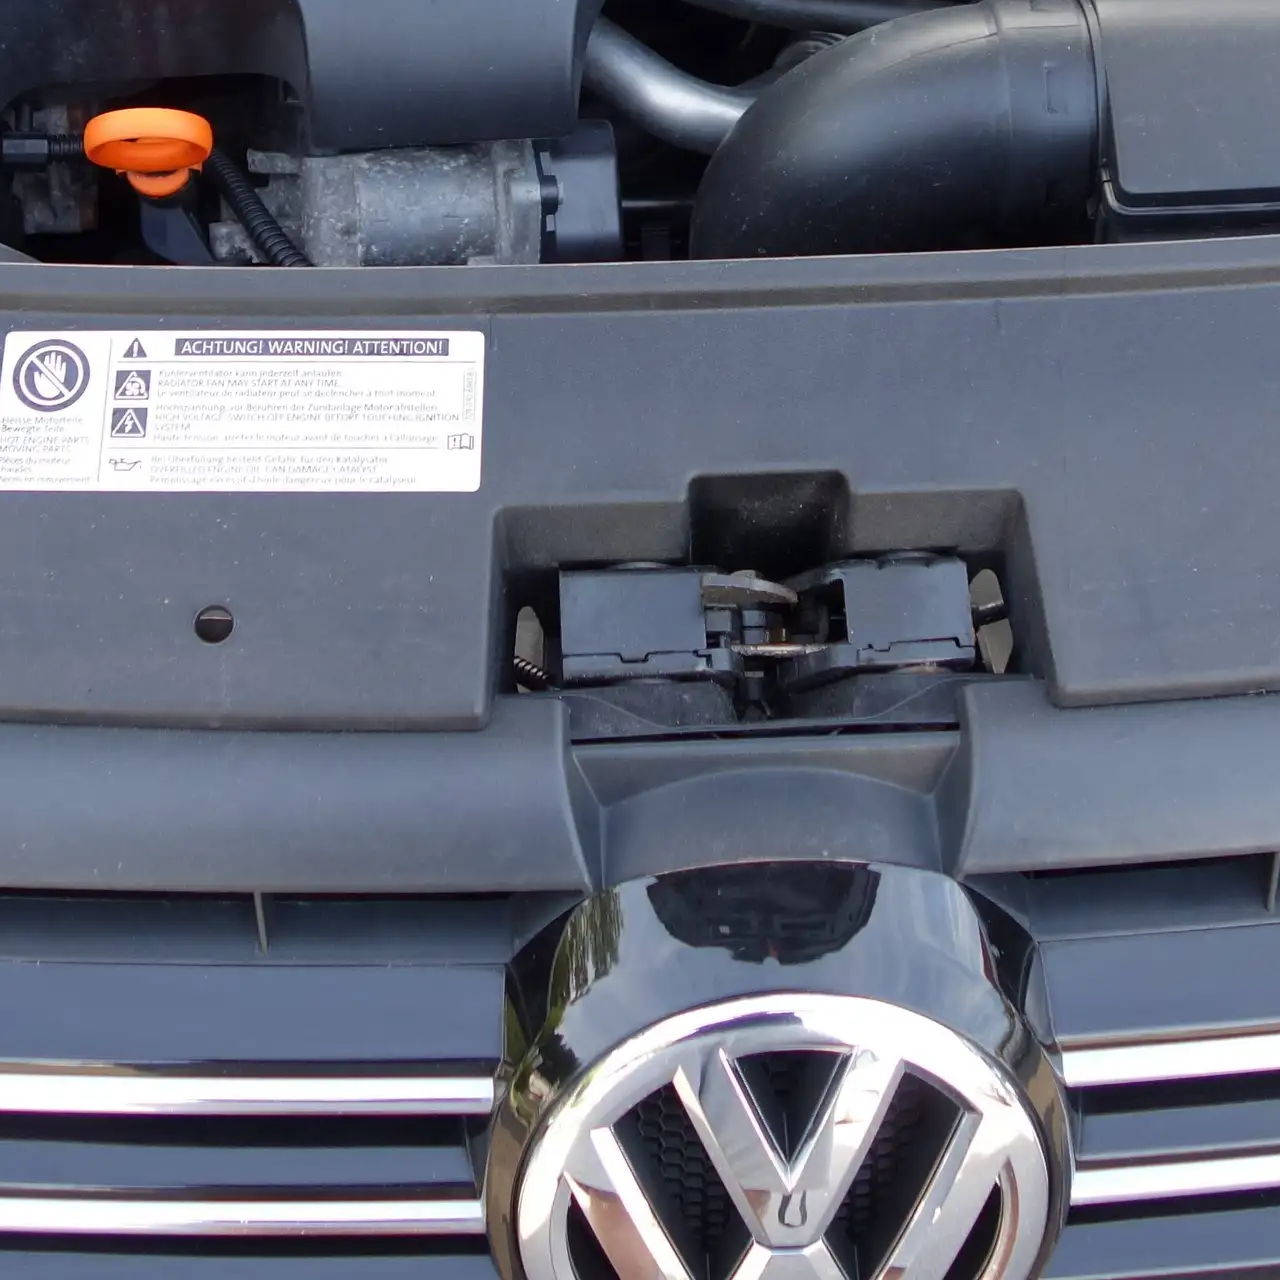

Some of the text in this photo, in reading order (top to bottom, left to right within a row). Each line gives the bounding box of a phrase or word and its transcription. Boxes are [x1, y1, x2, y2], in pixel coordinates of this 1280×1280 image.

[181, 340, 444, 354] ACHTUNG! WARNING! ATTENTION!
